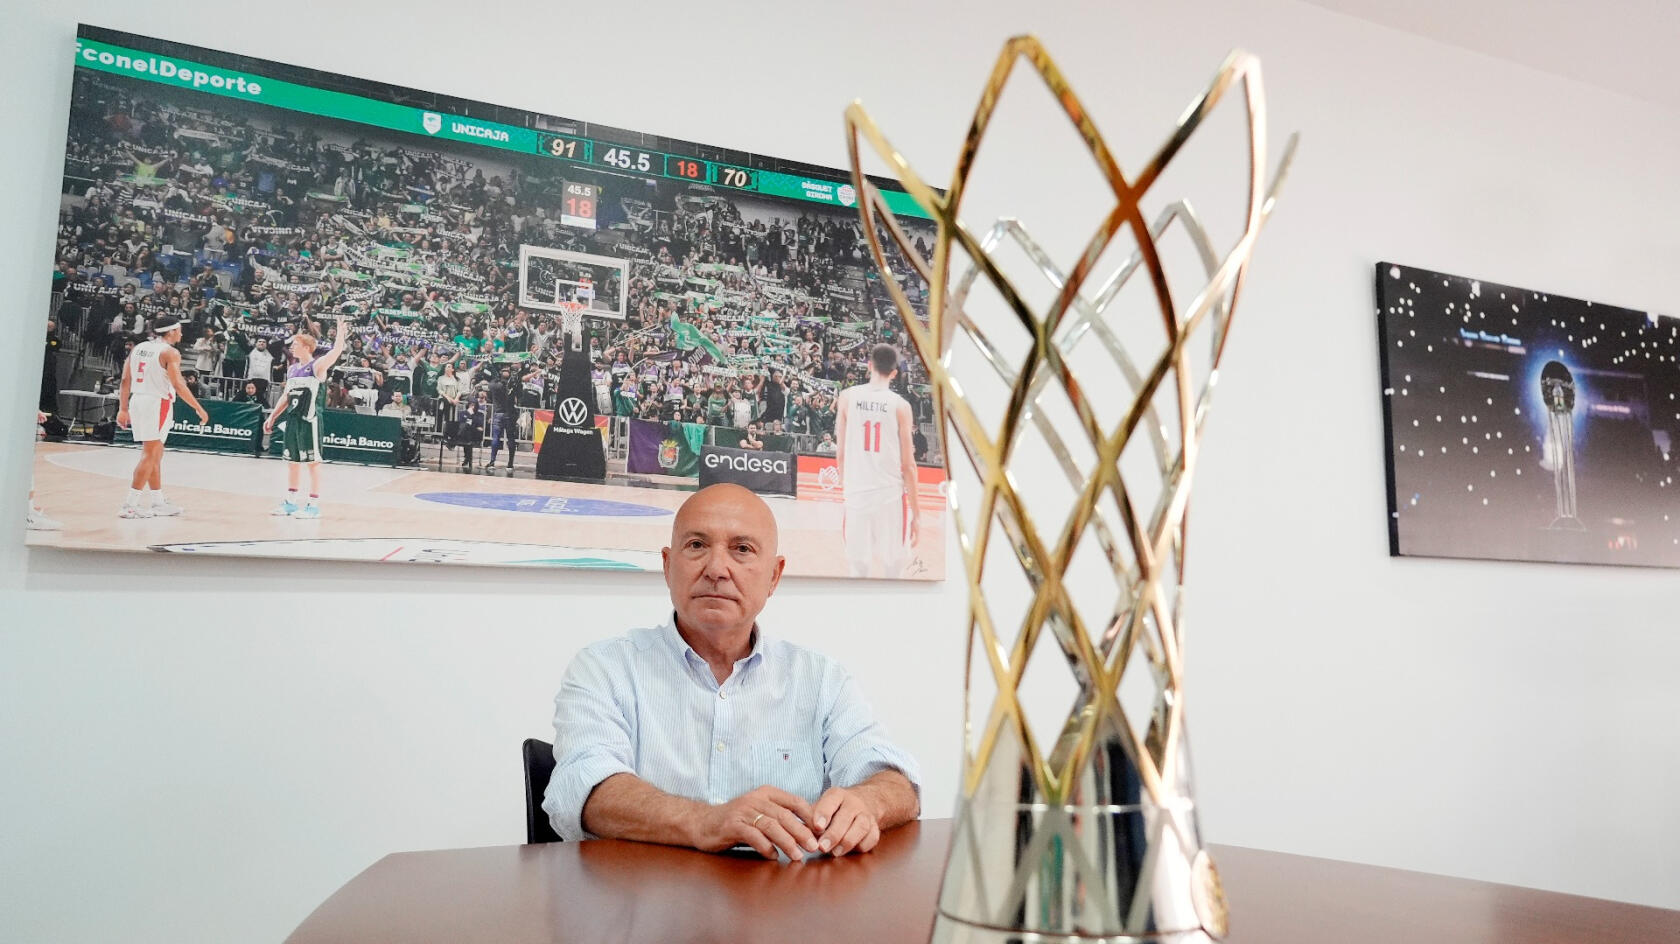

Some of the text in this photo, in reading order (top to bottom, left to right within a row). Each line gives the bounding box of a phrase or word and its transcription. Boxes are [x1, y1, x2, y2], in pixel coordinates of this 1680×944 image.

[452, 122, 747, 187] UNICAJA 91 45.5 18 70
[567, 184, 591, 197] 45.5
[567, 198, 593, 218] 18
[238, 323, 285, 335] UNICAJA
[173, 420, 252, 437] nicaja Banco
[863, 420, 881, 453] 11
[322, 433, 394, 449] nicaja Banco
[705, 453, 788, 475] endesa
